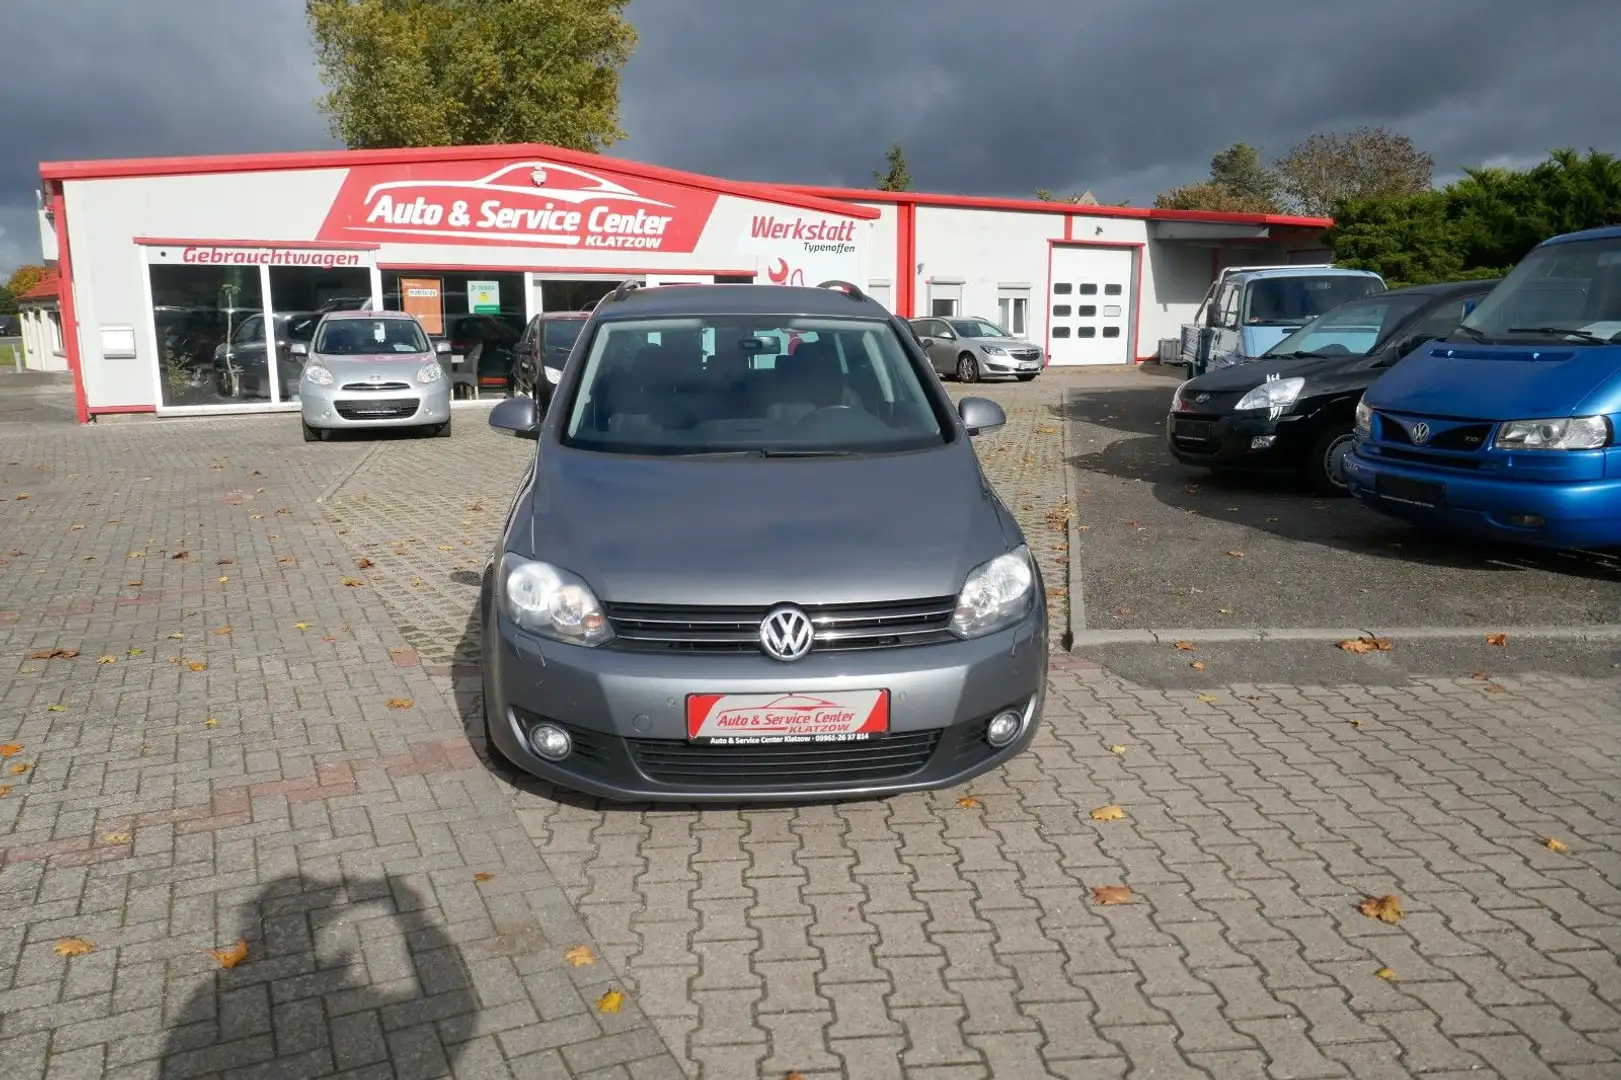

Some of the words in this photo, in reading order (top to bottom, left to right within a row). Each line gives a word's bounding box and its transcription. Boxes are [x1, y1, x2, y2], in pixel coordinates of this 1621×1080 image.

[366, 195, 444, 226] Auto
[447, 200, 471, 227] &
[476, 200, 581, 231] Service
[588, 206, 673, 235] Center
[751, 215, 856, 242] Werkstatt
[585, 235, 662, 249] KLATZOW
[803, 242, 855, 254] Typenoffen
[182, 246, 360, 269] Gebrauchtwagen
[717, 715, 748, 726] Auto
[751, 715, 760, 726] &
[763, 713, 811, 725] Service
[815, 711, 856, 723] Center
[789, 724, 850, 733] KLATZOW
[815, 734, 846, 742] 03961-26
[847, 733, 855, 741] 37
